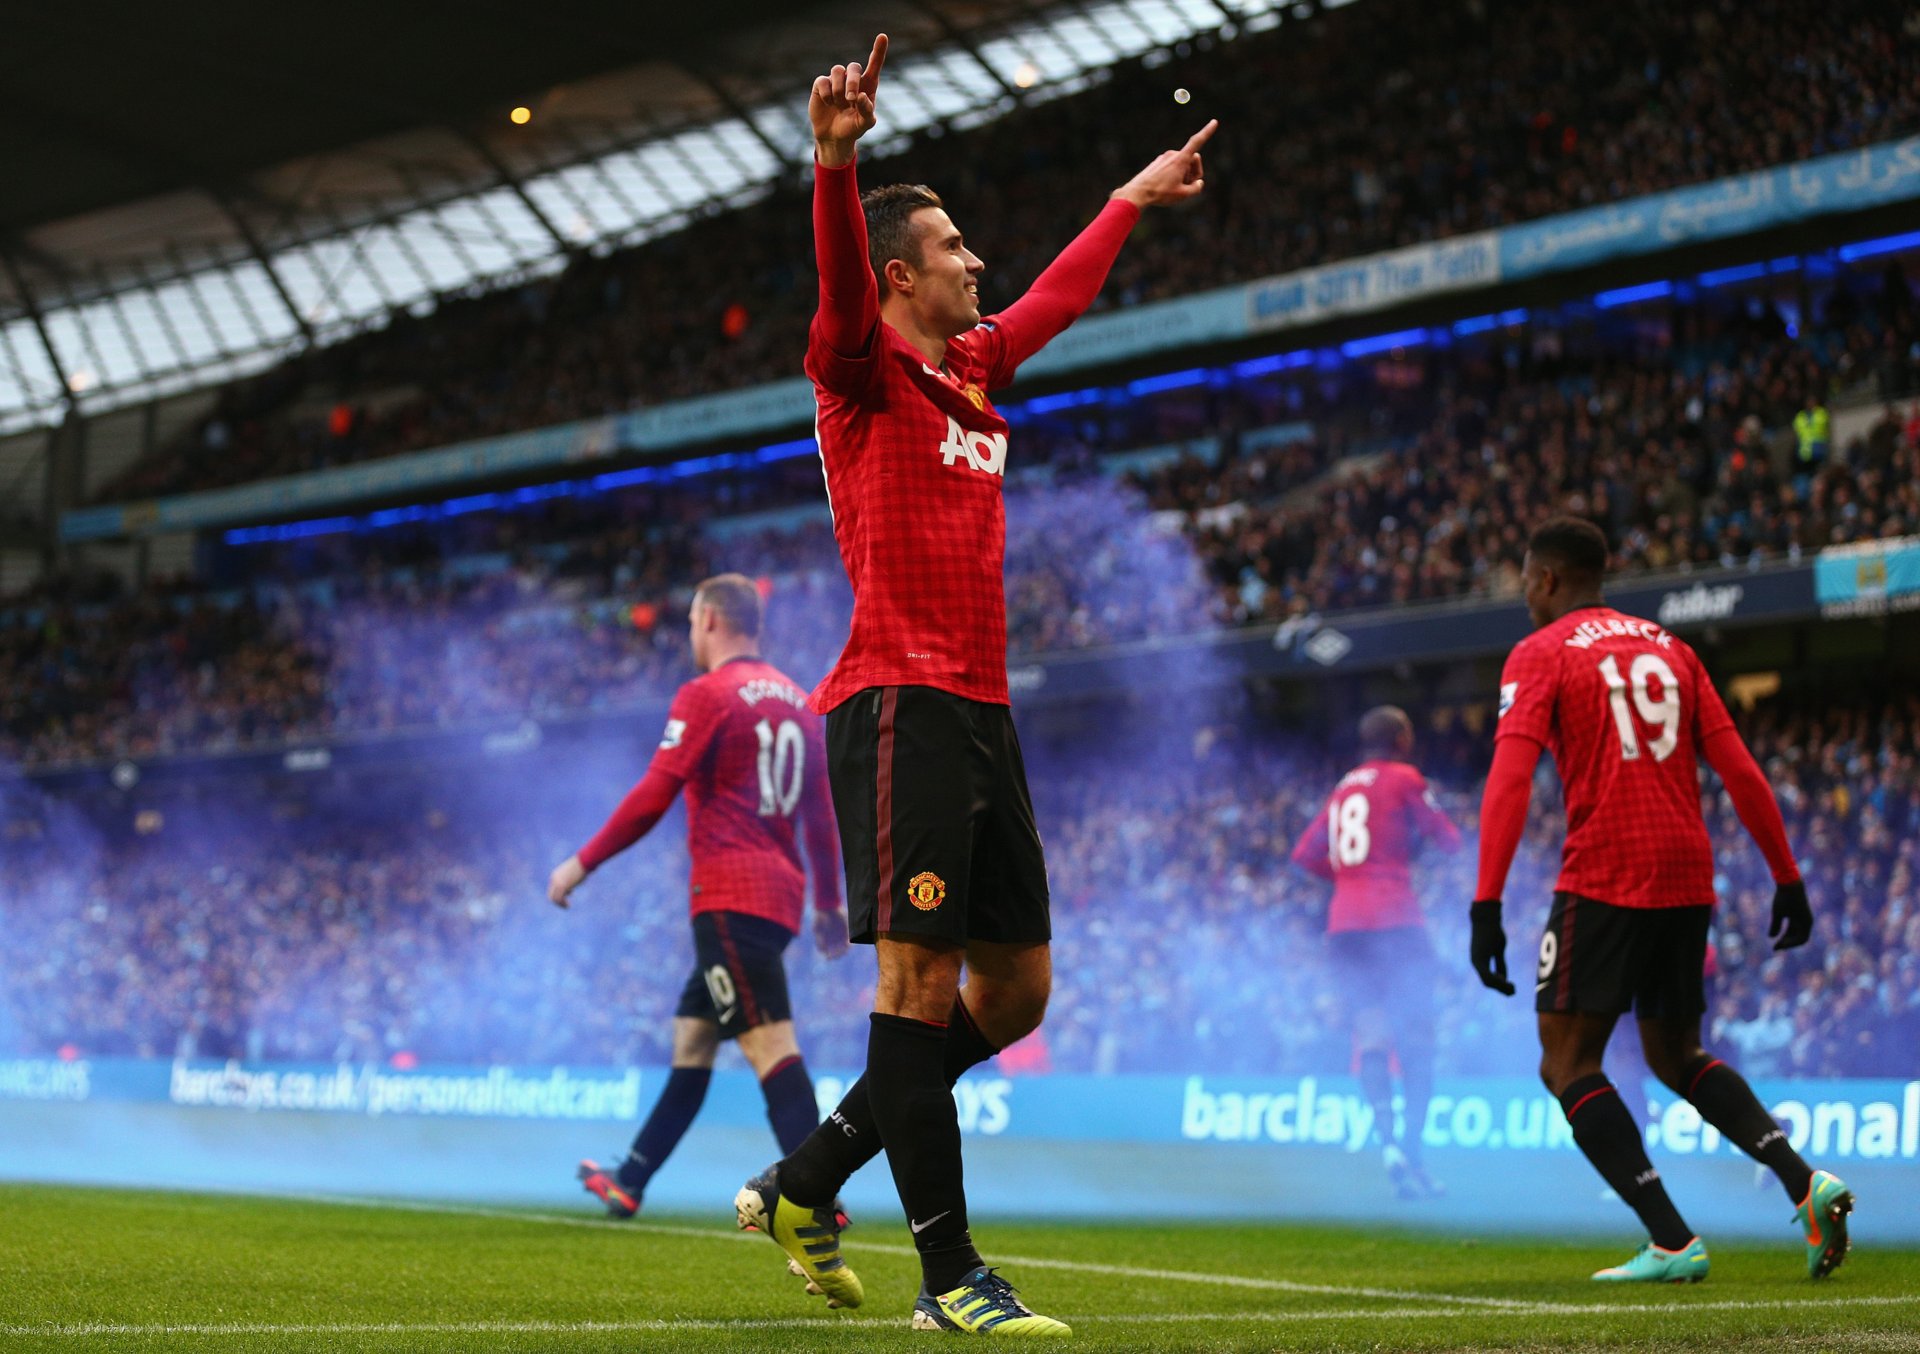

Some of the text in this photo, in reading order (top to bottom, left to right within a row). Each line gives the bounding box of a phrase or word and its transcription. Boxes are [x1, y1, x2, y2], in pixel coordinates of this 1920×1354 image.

[907, 652, 931, 660] DRI-FIT
[1564, 618, 1673, 650] WELBECK
[1598, 653, 1680, 763] 19
[755, 717, 806, 817] 10
[1328, 793, 1370, 871] 18
